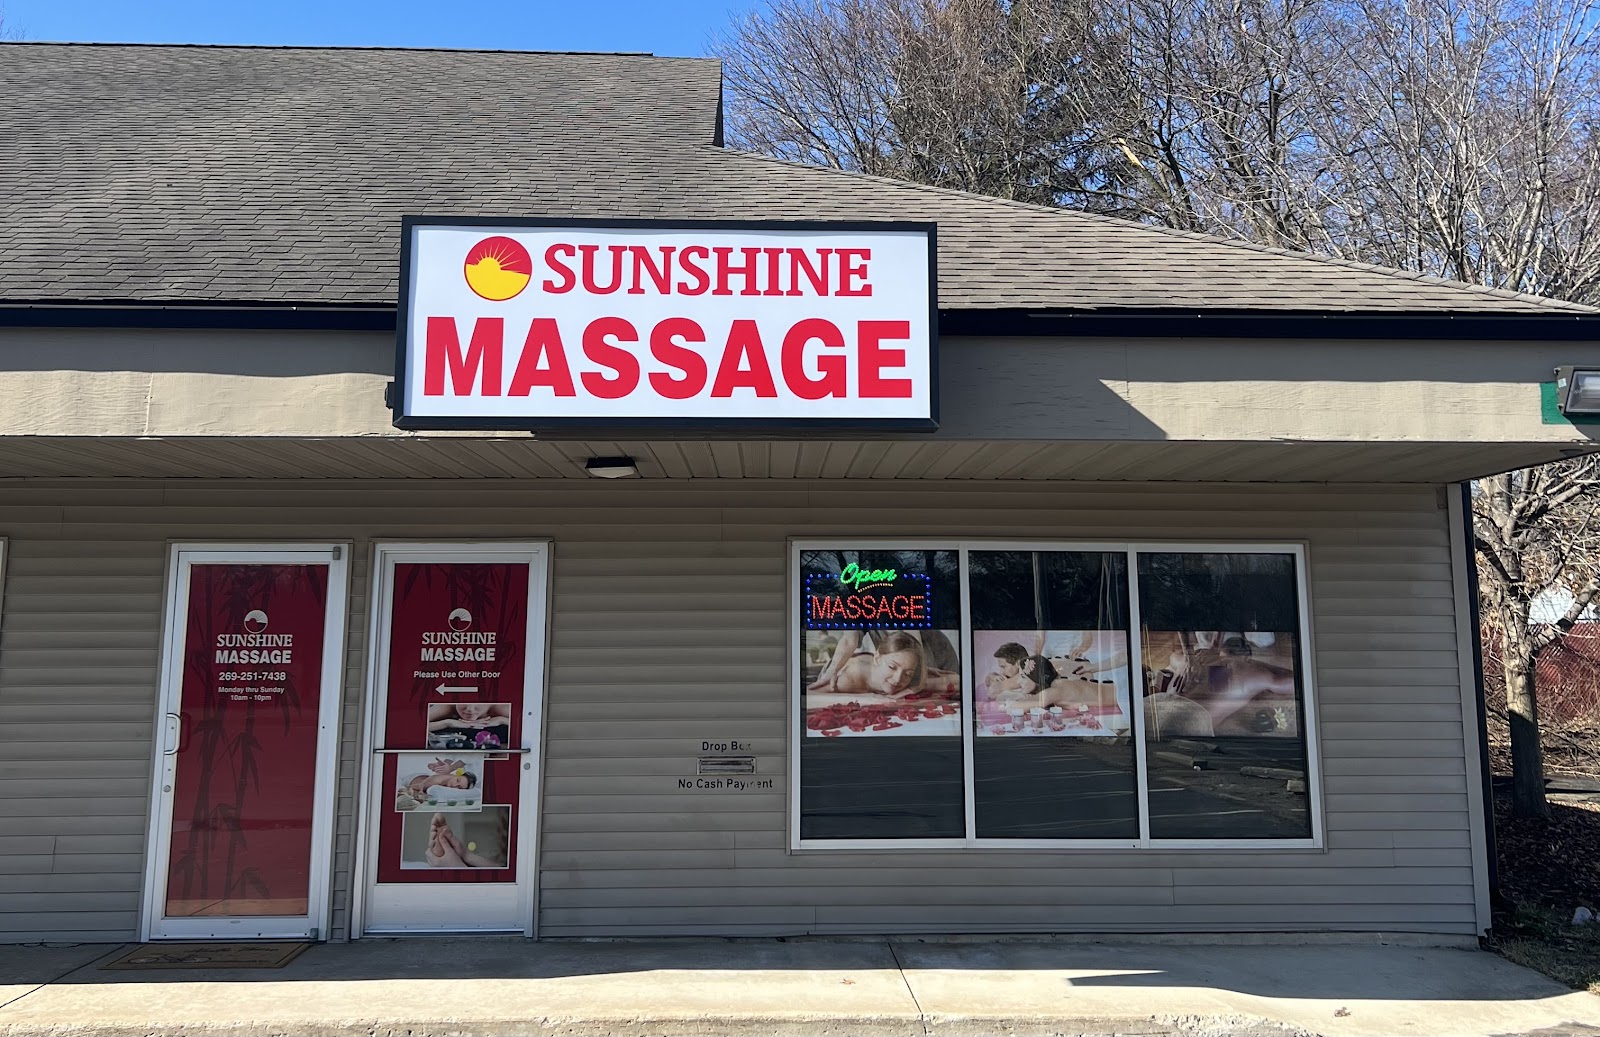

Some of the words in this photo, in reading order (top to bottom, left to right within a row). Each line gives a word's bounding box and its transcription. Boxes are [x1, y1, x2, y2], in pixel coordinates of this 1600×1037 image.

[542, 243, 873, 297] SUNSHINE
[423, 316, 913, 400] MASSAGE
[840, 562, 897, 590] Open
[811, 594, 925, 620] MASSAGE
[216, 633, 293, 647] SUNSHINE
[421, 631, 497, 645] SUNSHINE
[215, 649, 292, 664] MASSAGE
[420, 647, 496, 662] MASSAGE
[218, 671, 287, 681] 269-251-7438
[413, 670, 440, 678] Please
[441, 670, 457, 678] Use
[458, 670, 481, 678] Other
[481, 670, 501, 678] Door
[218, 686, 244, 694] Monday
[260, 686, 285, 694] Sunday
[254, 694, 272, 702] 10pm
[702, 741, 727, 752] Drop
[678, 779, 693, 789] No
[696, 778, 723, 789] Cash
